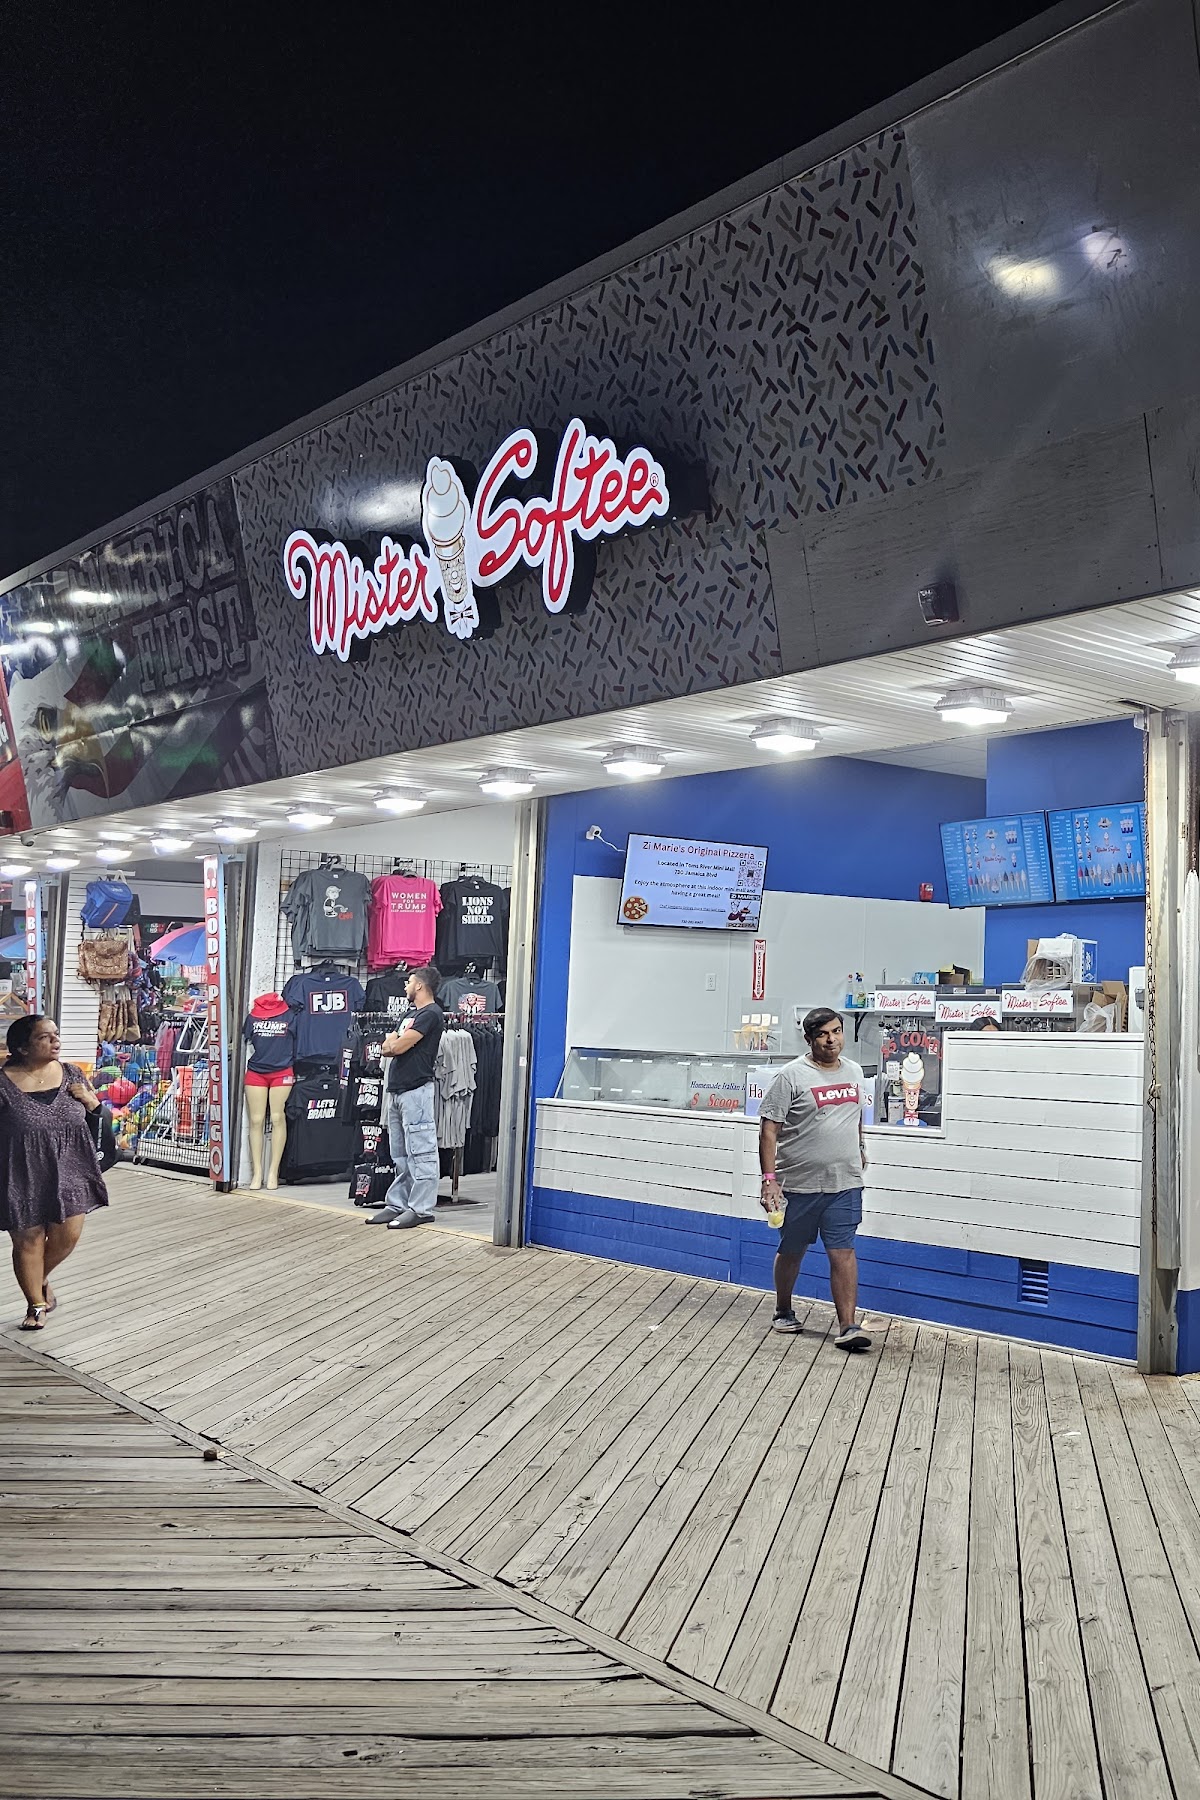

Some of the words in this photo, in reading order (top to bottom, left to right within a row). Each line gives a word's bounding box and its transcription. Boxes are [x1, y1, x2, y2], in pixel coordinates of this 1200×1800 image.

[287, 537, 434, 653] Mister
[477, 428, 663, 603] Softee
[132, 584, 246, 694] FIRST
[653, 842, 686, 854] Marie's
[687, 845, 721, 857] Original
[723, 849, 755, 860] Pizzeria
[634, 879, 650, 887] Enjoy
[391, 902, 427, 910] TRUMP
[461, 896, 494, 906] LIONS
[466, 905, 489, 915] NOT
[461, 914, 494, 925] SHEEP
[206, 897, 219, 974] BODY
[26, 917, 37, 979] BODY
[312, 992, 346, 1012] FJB
[877, 992, 901, 1009] Mister
[906, 992, 931, 1010] Softee
[1004, 991, 1032, 1009] Mister
[1039, 992, 1068, 1011] Softee
[938, 1002, 964, 1020] Mister
[970, 1002, 998, 1021] Softee
[252, 1020, 287, 1030] TRUMP
[208, 984, 222, 1142] PIERCING
[690, 1080, 721, 1090] Homemade
[721, 1082, 740, 1091] Italian
[707, 1093, 739, 1113] Scoop
